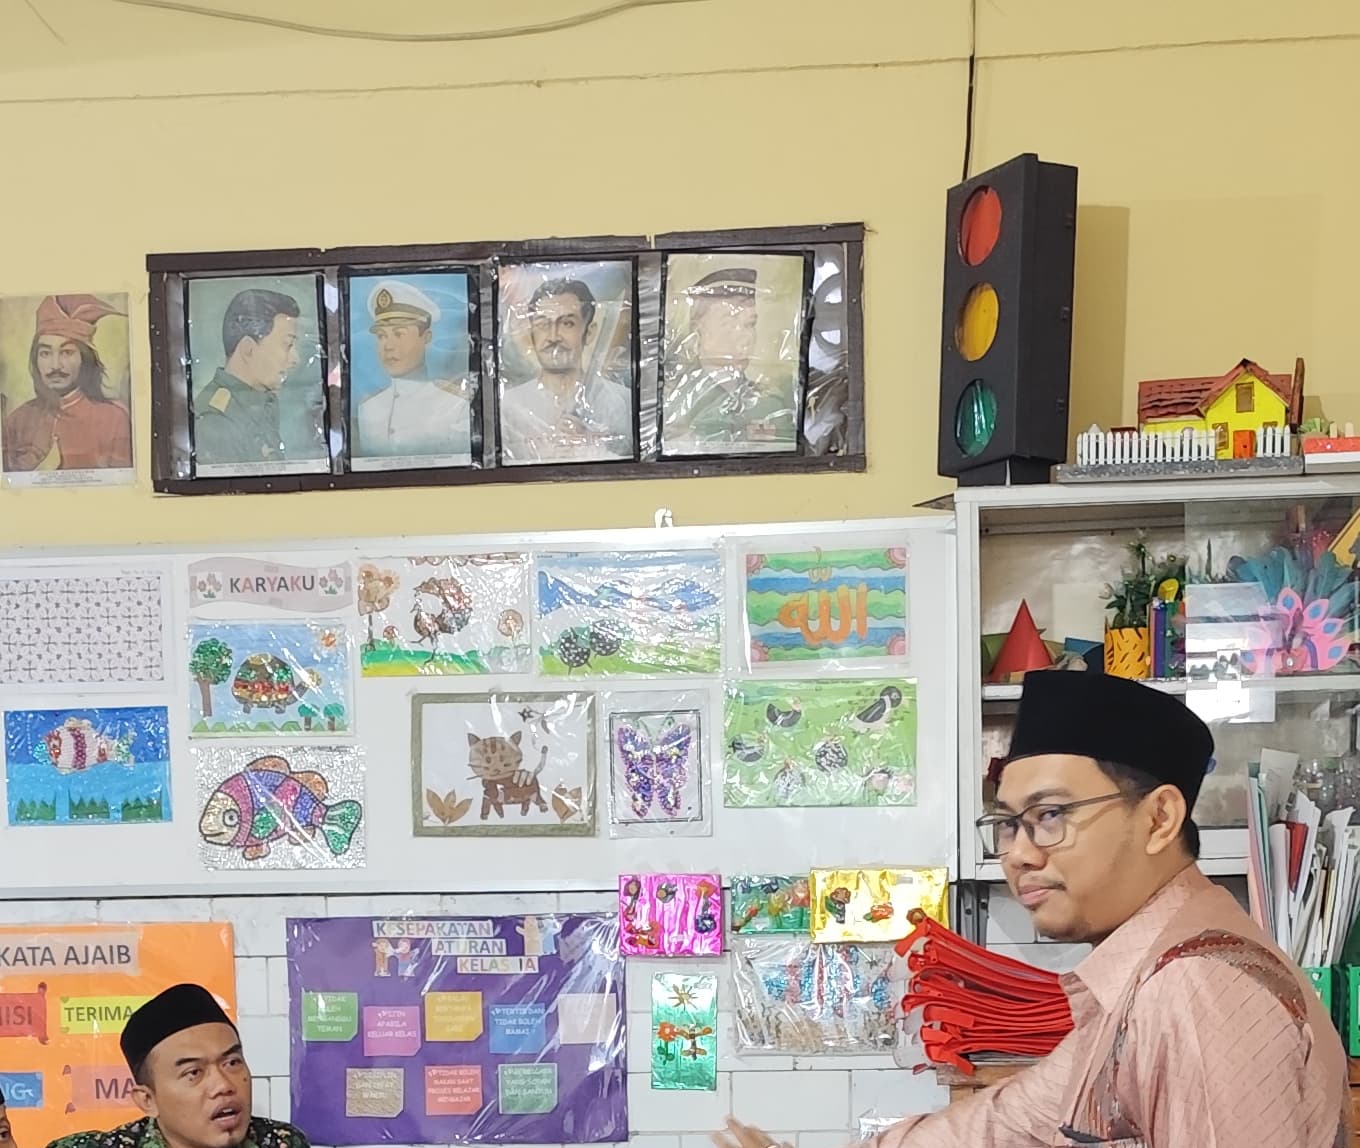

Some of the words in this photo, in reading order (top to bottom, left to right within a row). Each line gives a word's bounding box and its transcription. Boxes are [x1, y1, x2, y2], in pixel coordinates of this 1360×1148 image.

[230, 576, 315, 593] KARYAKU
[376, 922, 491, 936] KESEPAKATAN
[63, 944, 132, 965] AJAIB
[435, 940, 503, 954] ATURAN
[459, 959, 511, 972] KELAS
[65, 1005, 133, 1022] TERIMA
